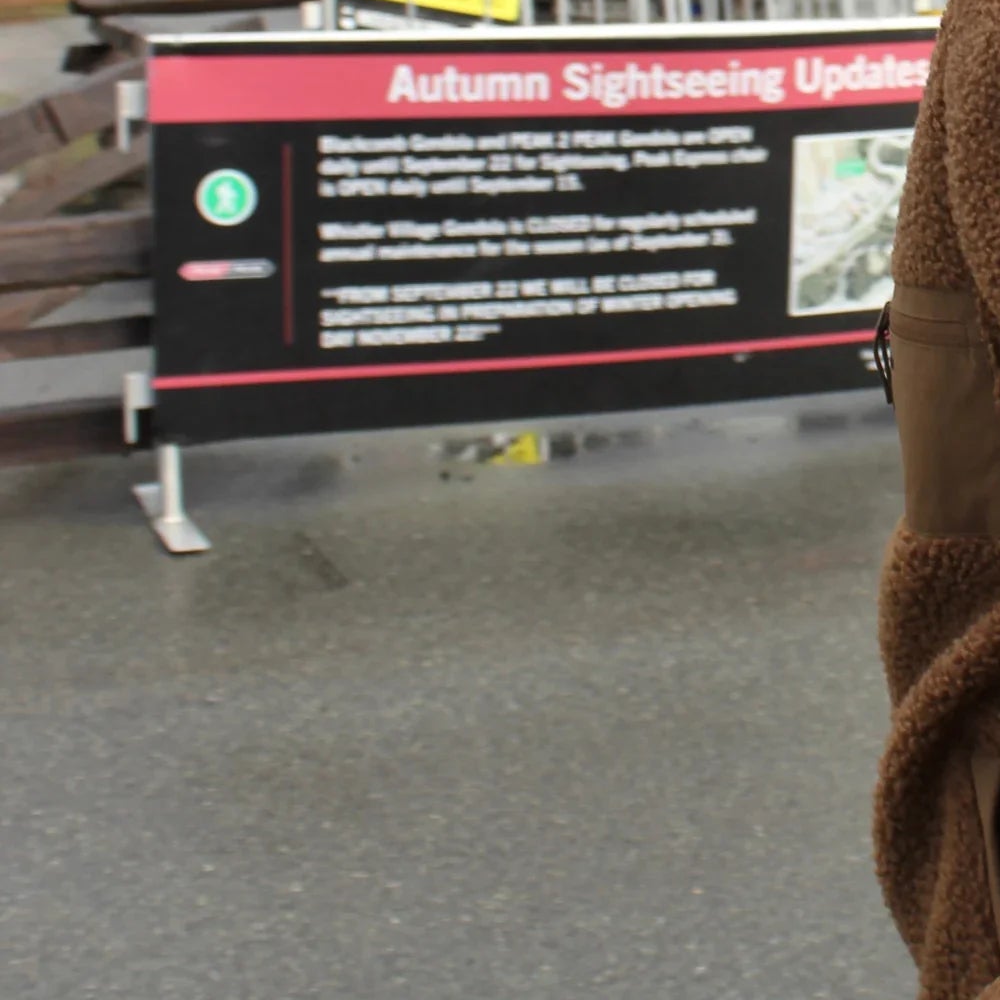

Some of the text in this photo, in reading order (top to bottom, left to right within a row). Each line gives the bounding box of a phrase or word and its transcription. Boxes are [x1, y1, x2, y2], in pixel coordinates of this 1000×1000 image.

[387, 54, 930, 109] Autumn Sightseeing Updates
